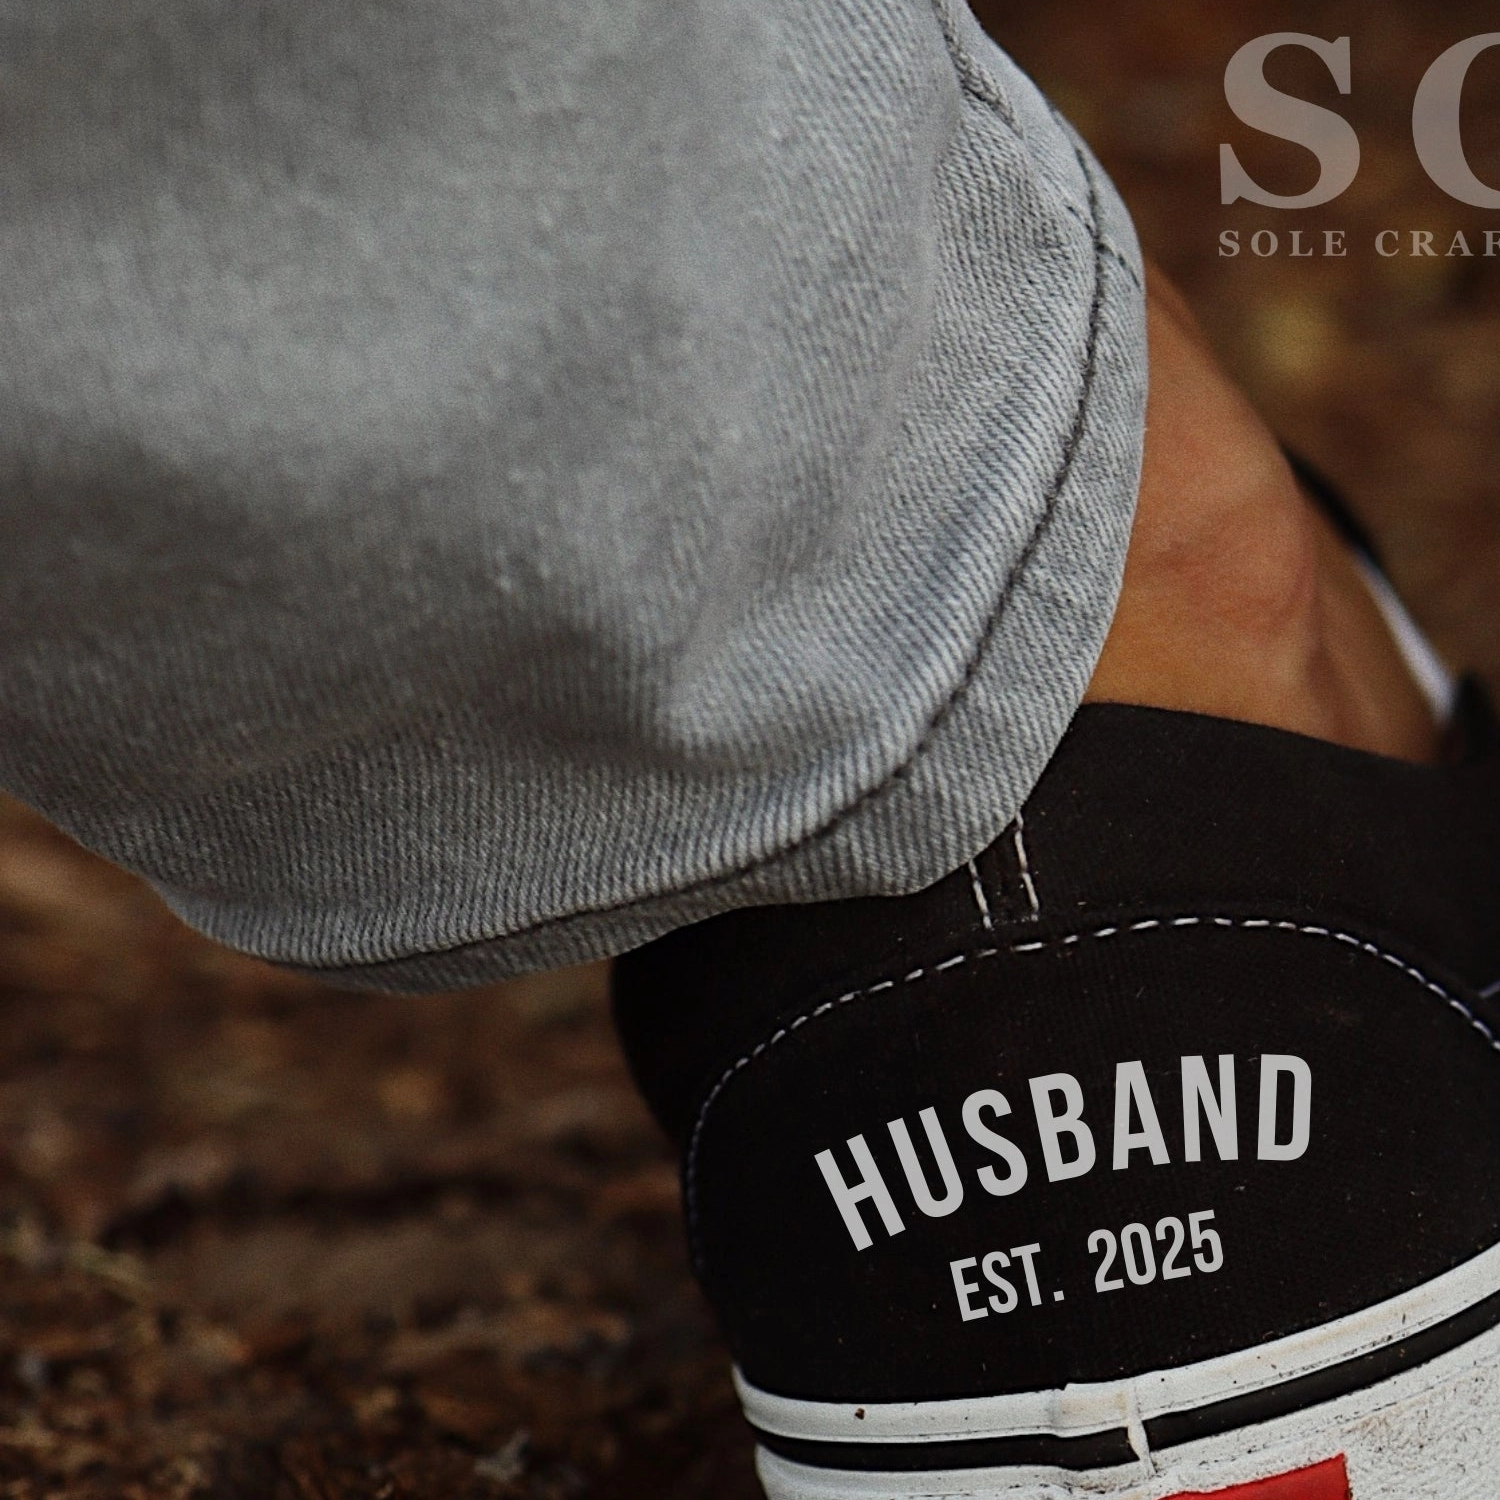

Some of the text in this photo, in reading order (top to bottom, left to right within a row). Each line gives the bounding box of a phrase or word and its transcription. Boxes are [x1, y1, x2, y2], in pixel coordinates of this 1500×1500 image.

[814, 1053, 1312, 1251] HUSBAND
[950, 1210, 1224, 1321] EST. 2025
